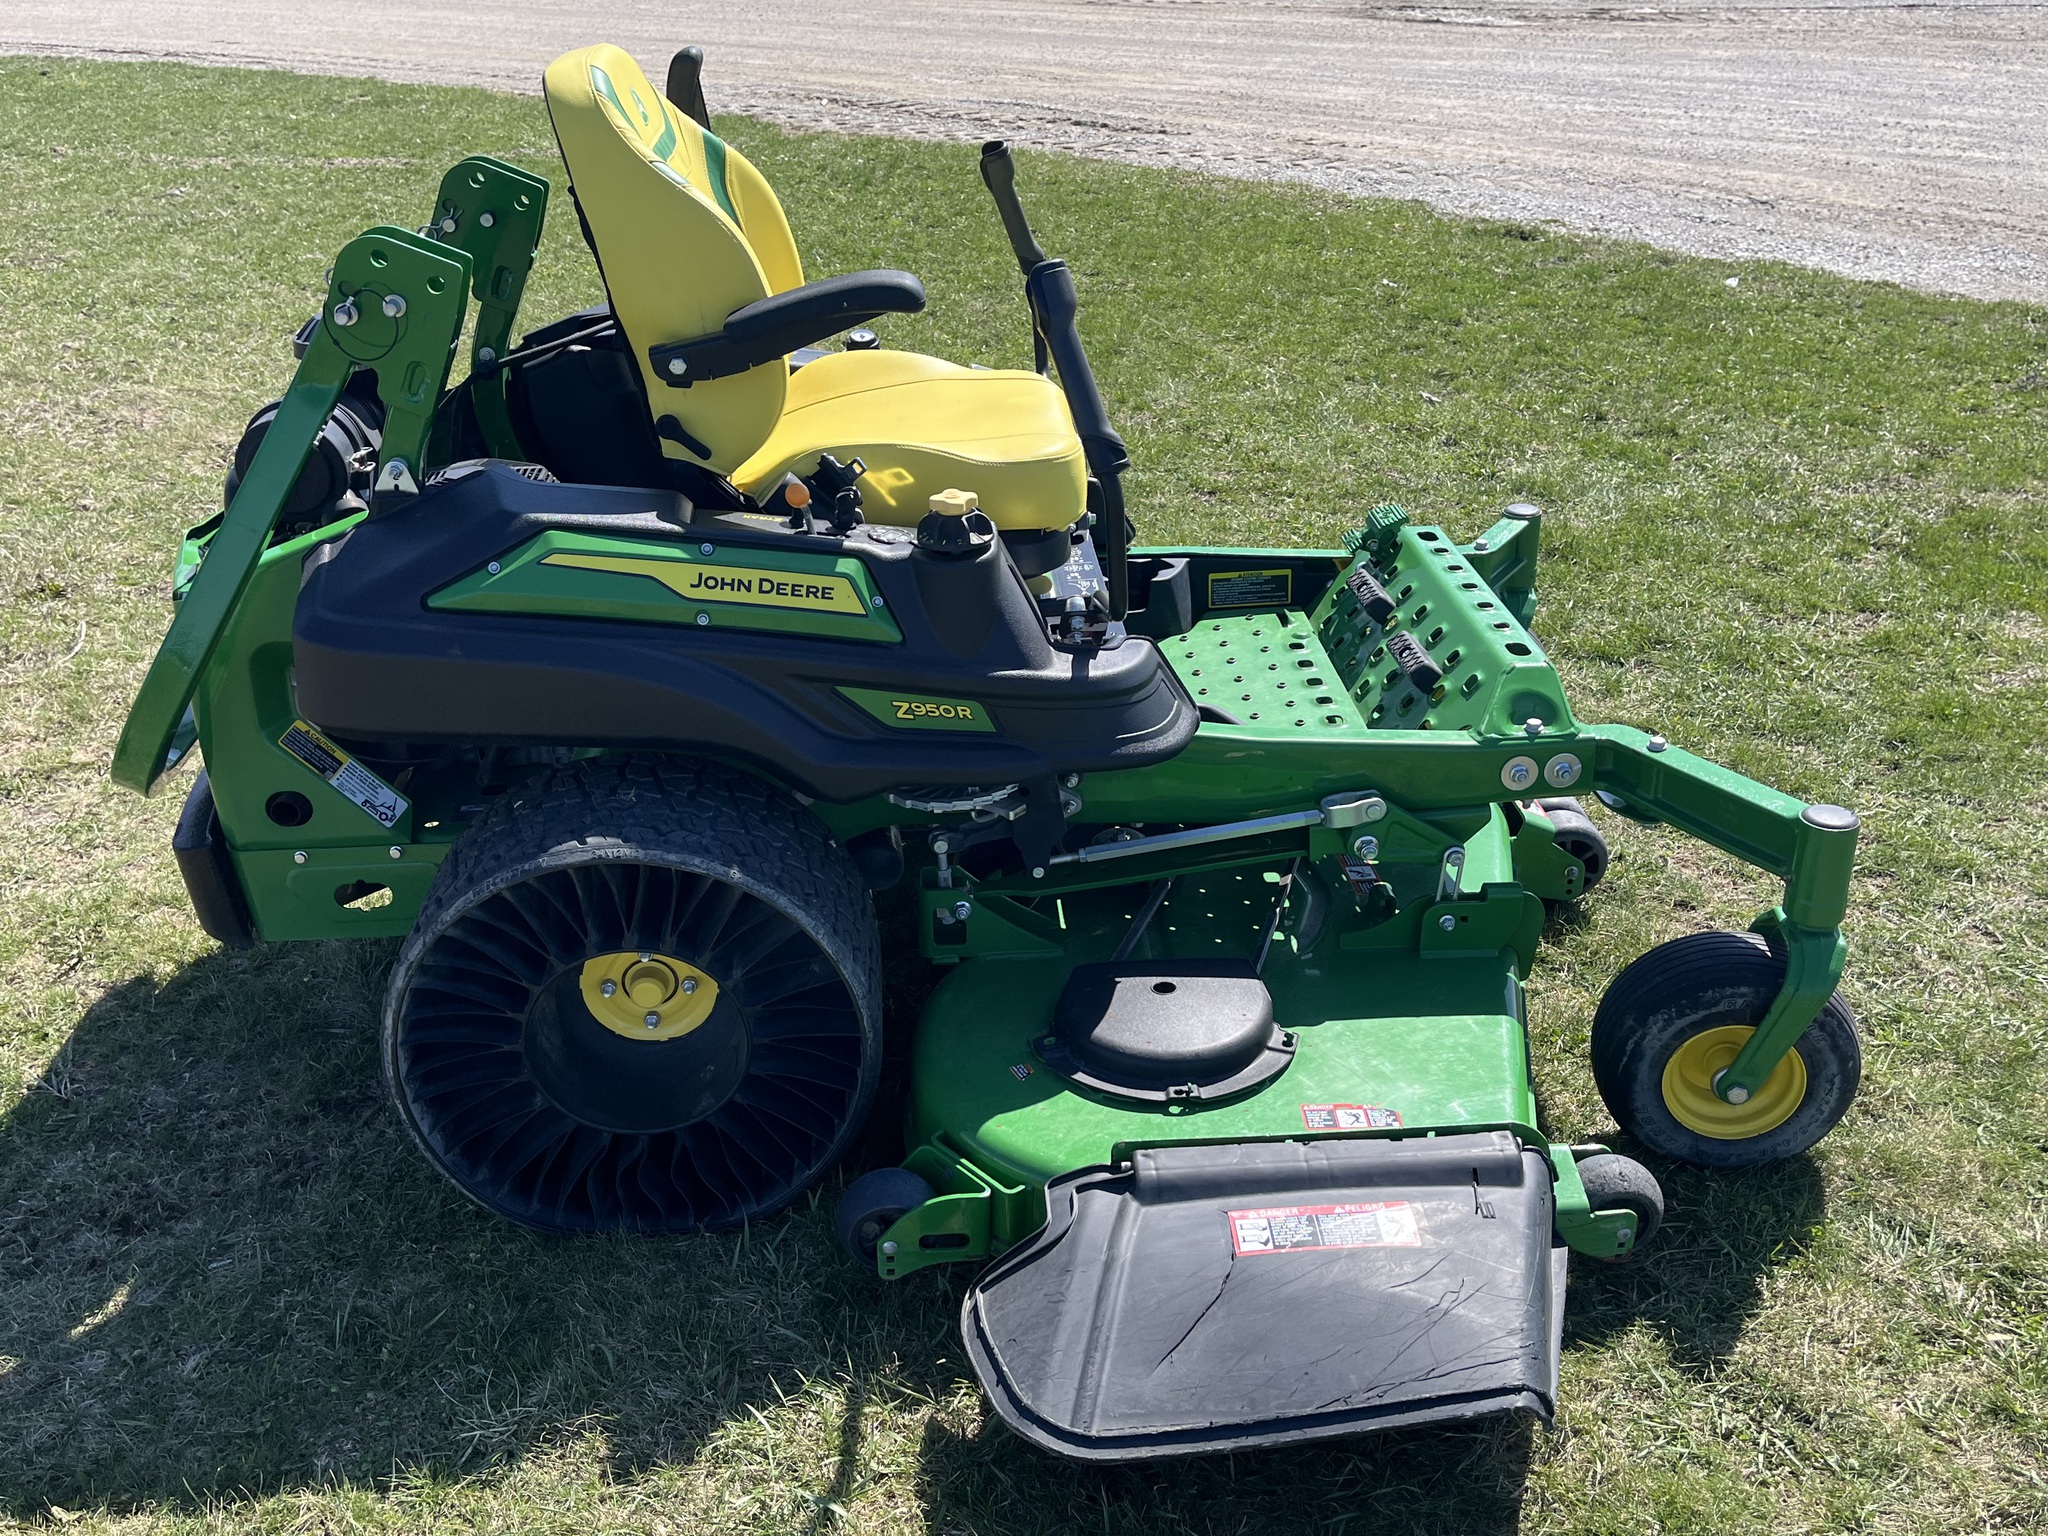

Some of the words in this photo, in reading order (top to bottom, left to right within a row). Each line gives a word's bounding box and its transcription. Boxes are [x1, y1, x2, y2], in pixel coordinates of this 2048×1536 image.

[690, 572, 752, 593] JOHN
[758, 578, 834, 600] DEERE
[891, 700, 976, 720] Z950R
[310, 733, 337, 755] CAUTION
[1259, 1207, 1299, 1218] DANGER
[1344, 1202, 1386, 1213] PELIGRO
